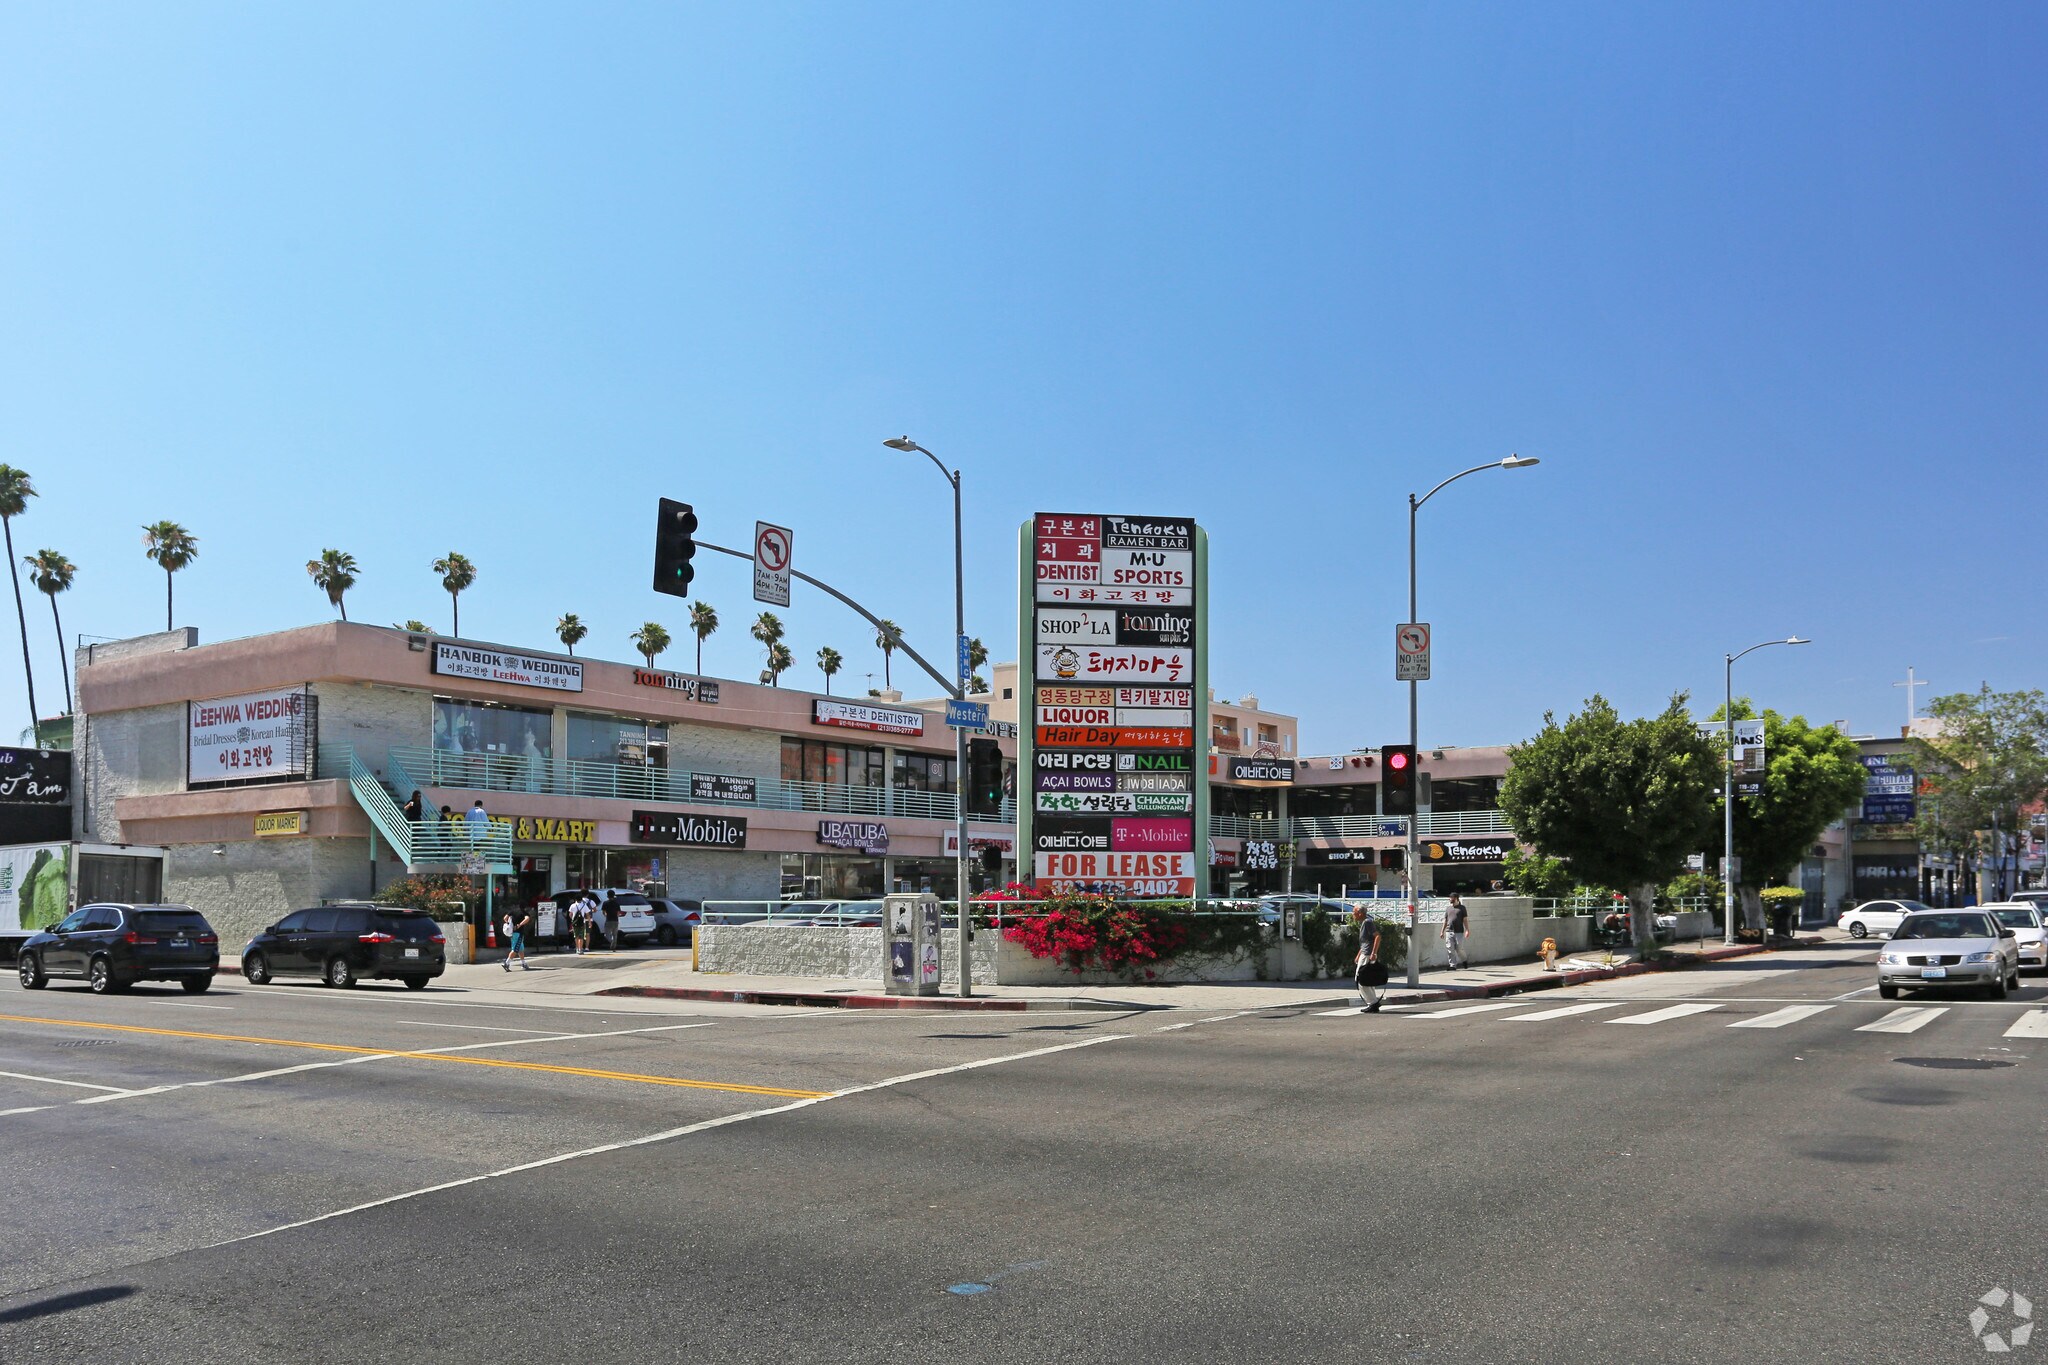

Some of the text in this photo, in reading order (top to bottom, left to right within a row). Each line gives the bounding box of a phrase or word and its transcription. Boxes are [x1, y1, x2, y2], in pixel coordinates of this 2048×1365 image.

[1110, 537, 1184, 548] RAMEN BAR
[1038, 564, 1098, 580] DENTIST
[1114, 570, 1183, 585] SPORTS
[1122, 612, 1191, 642] tanning
[440, 648, 580, 676] HANBOK WEDDING
[1087, 652, 1183, 681] 돼지마을
[1400, 655, 1411, 663] NO
[634, 670, 699, 700] tanning
[1041, 690, 1110, 704] 영동당구장
[1120, 690, 1189, 706] 럭키발지압
[194, 696, 301, 728] LEEHWA WEDDING
[871, 710, 918, 725] DENTISTRY
[949, 707, 986, 722] Western
[1043, 709, 1109, 724] LIQUOR
[194, 734, 212, 746] Bridal
[213, 733, 236, 745] Dresses
[251, 729, 274, 740] Korean
[1045, 728, 1120, 745] Hair Day
[1138, 756, 1189, 769] NAIL
[720, 777, 754, 785] TANNING
[1042, 777, 1111, 790] AÇAI BOWLS
[1137, 796, 1185, 805] CHAKAN
[256, 817, 298, 831] LIQUOR MARKET
[517, 818, 530, 839] &
[535, 819, 595, 842] MART
[822, 823, 887, 840] UBATUBA
[1048, 854, 1182, 876] FOR LEASE
